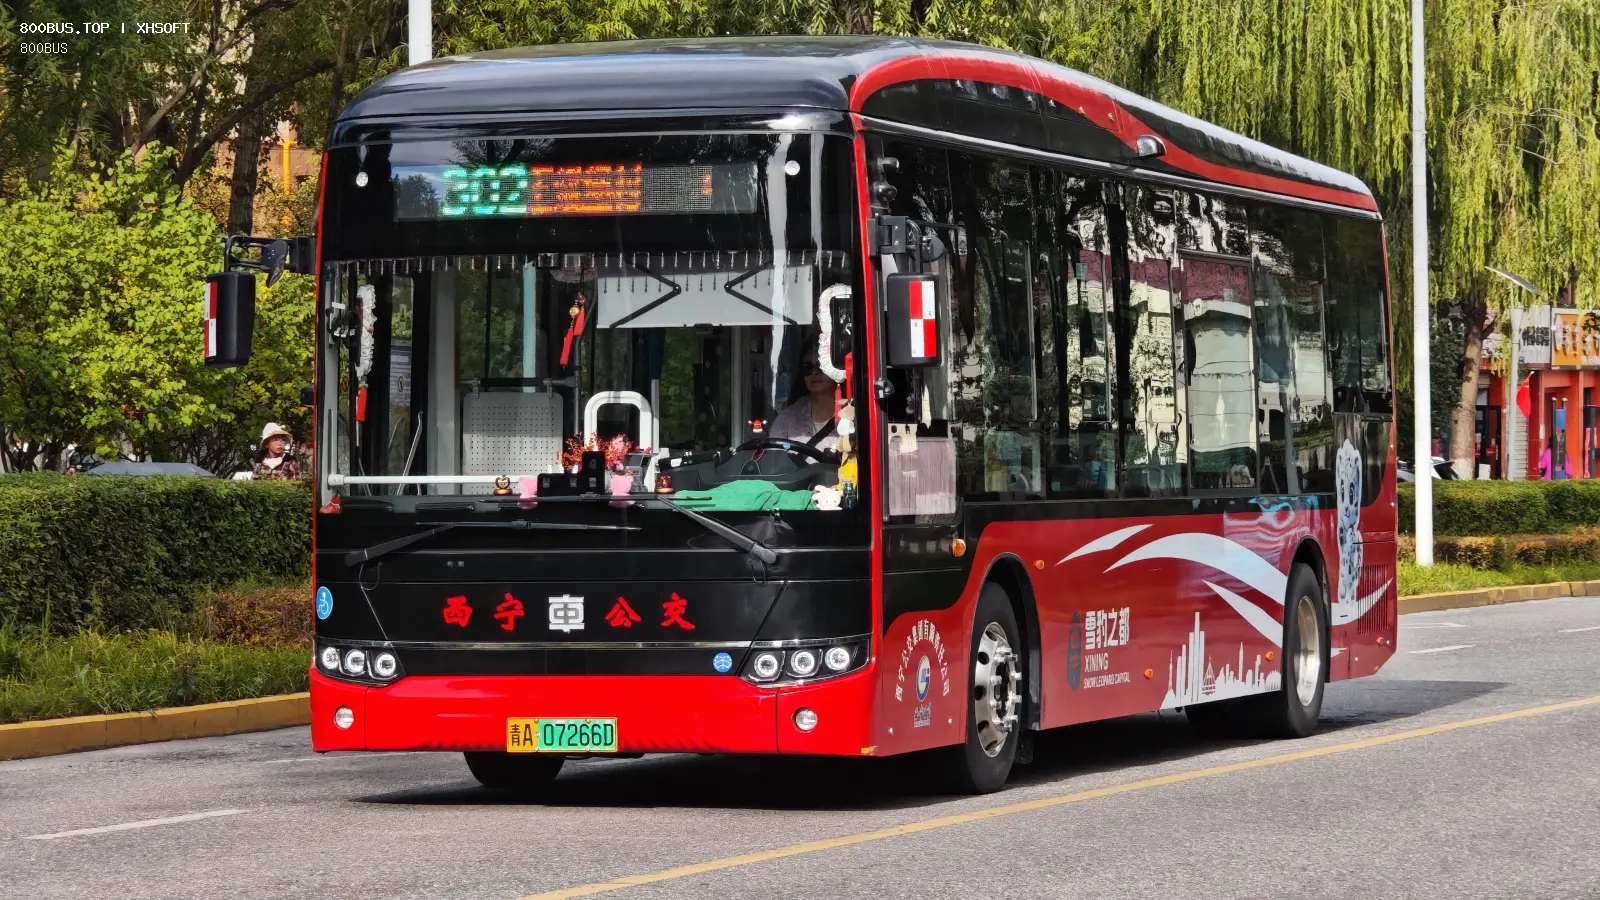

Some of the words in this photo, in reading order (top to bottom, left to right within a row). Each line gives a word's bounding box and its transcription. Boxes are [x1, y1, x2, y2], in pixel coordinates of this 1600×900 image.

[442, 592, 525, 632] 西宁
[604, 592, 696, 631] 公交
[1085, 607, 1130, 650] 雪豹之都
[1084, 652, 1109, 673] XINING
[1096, 673, 1114, 687] LEOPARD
[1114, 671, 1131, 684] CAPITAL
[510, 723, 534, 747] 青A
[543, 723, 615, 747] 07266D
